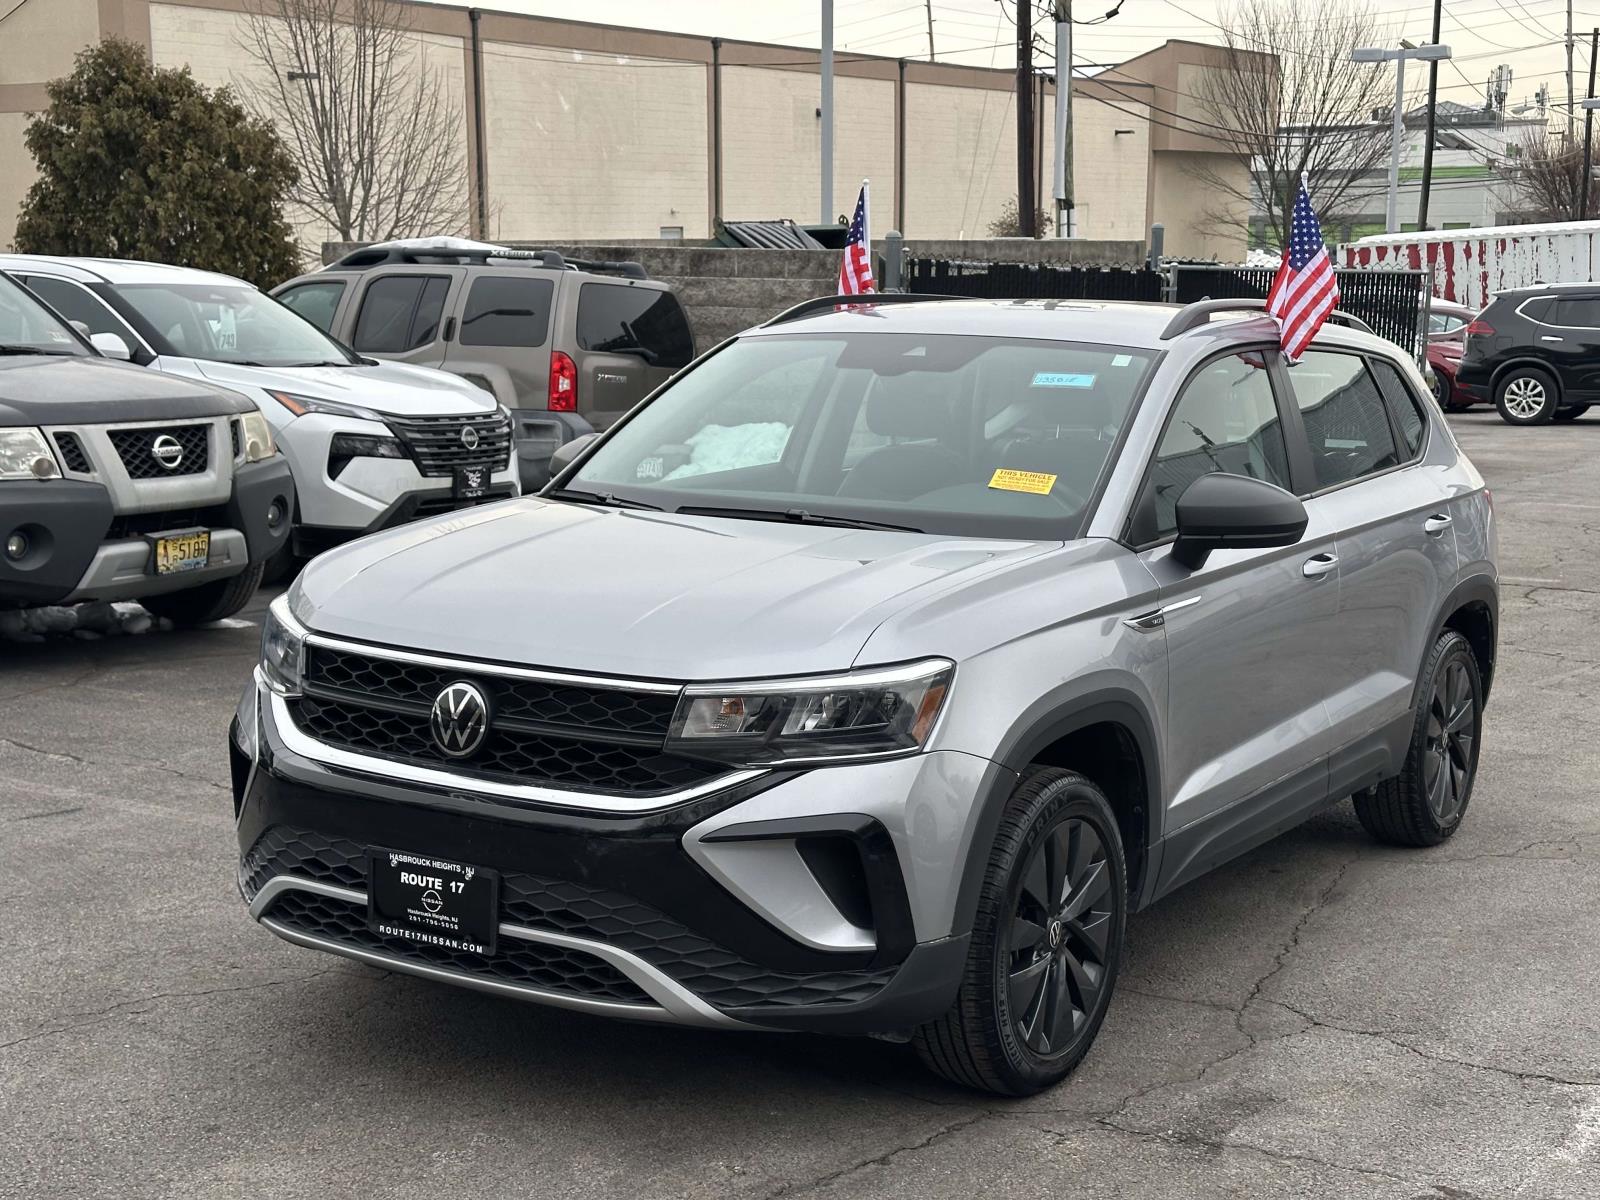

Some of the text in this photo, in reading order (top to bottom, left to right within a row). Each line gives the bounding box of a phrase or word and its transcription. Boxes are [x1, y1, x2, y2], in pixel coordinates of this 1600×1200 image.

[1019, 471, 1053, 480] VEHICLE
[389, 853, 431, 867] HASBROUCK
[465, 866, 475, 876] NJ
[400, 871, 465, 894] ROUTE 17
[421, 897, 443, 905] NISSAN
[379, 925, 483, 953] ROUTE17NISSAN.COM
